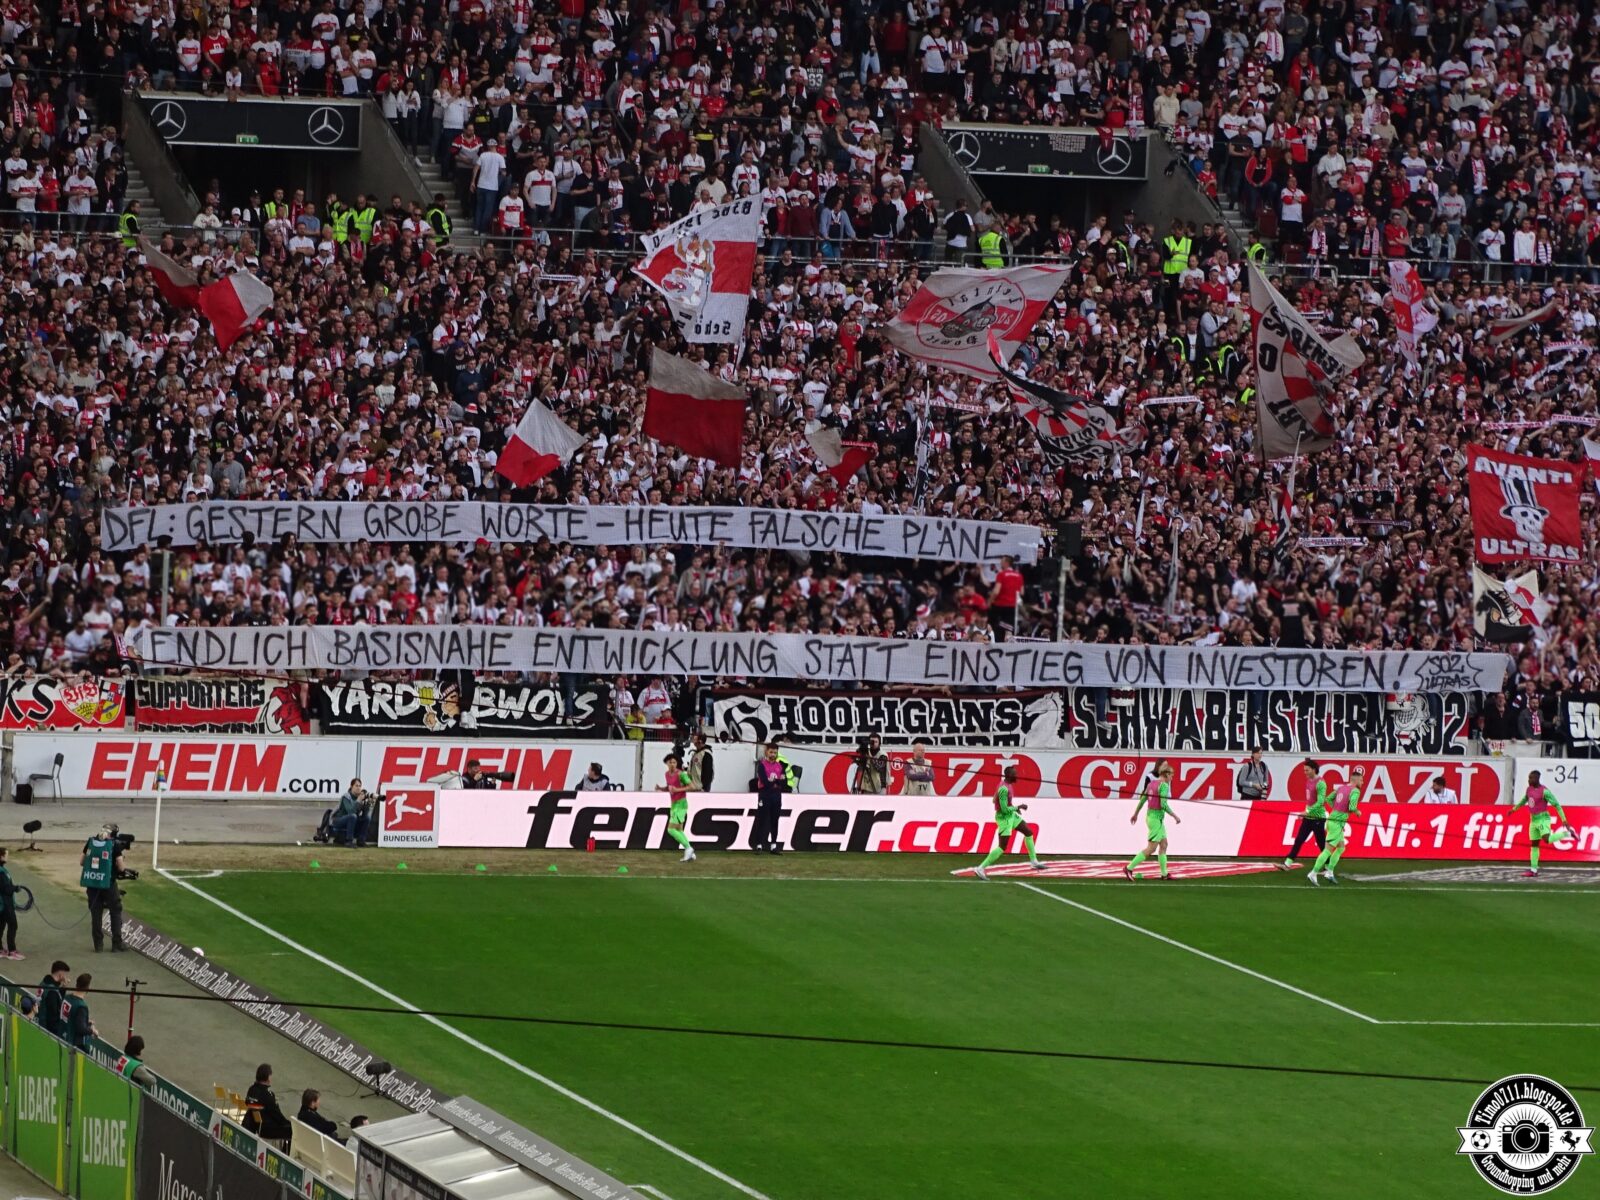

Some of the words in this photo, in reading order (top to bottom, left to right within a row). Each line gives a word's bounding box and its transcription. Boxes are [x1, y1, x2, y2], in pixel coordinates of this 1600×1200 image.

[1474, 456, 1573, 484] AVANTI
[187, 505, 342, 539] GESTERN
[749, 512, 885, 551] FALSCHE
[1480, 538, 1580, 561] ULTRAS
[150, 630, 308, 667] ENDLICH
[326, 630, 513, 667] BASISNAHE
[534, 632, 778, 677] ENTWICKLUNG
[804, 638, 909, 677] STATT
[924, 643, 1084, 685] EINSTIEG
[1104, 648, 1167, 685] VON
[138, 679, 266, 709] SUPPORTERS
[322, 681, 420, 722] YARD
[765, 694, 1024, 736] HOOLIGANS
[87, 742, 286, 792] EHEIM
[383, 834, 434, 843] BUNDESLIGA
[1462, 812, 1522, 849] für
[83, 871, 106, 881] HOST
[18, 1075, 58, 1125] LIBARE
[82, 1116, 127, 1168] LIBARE
